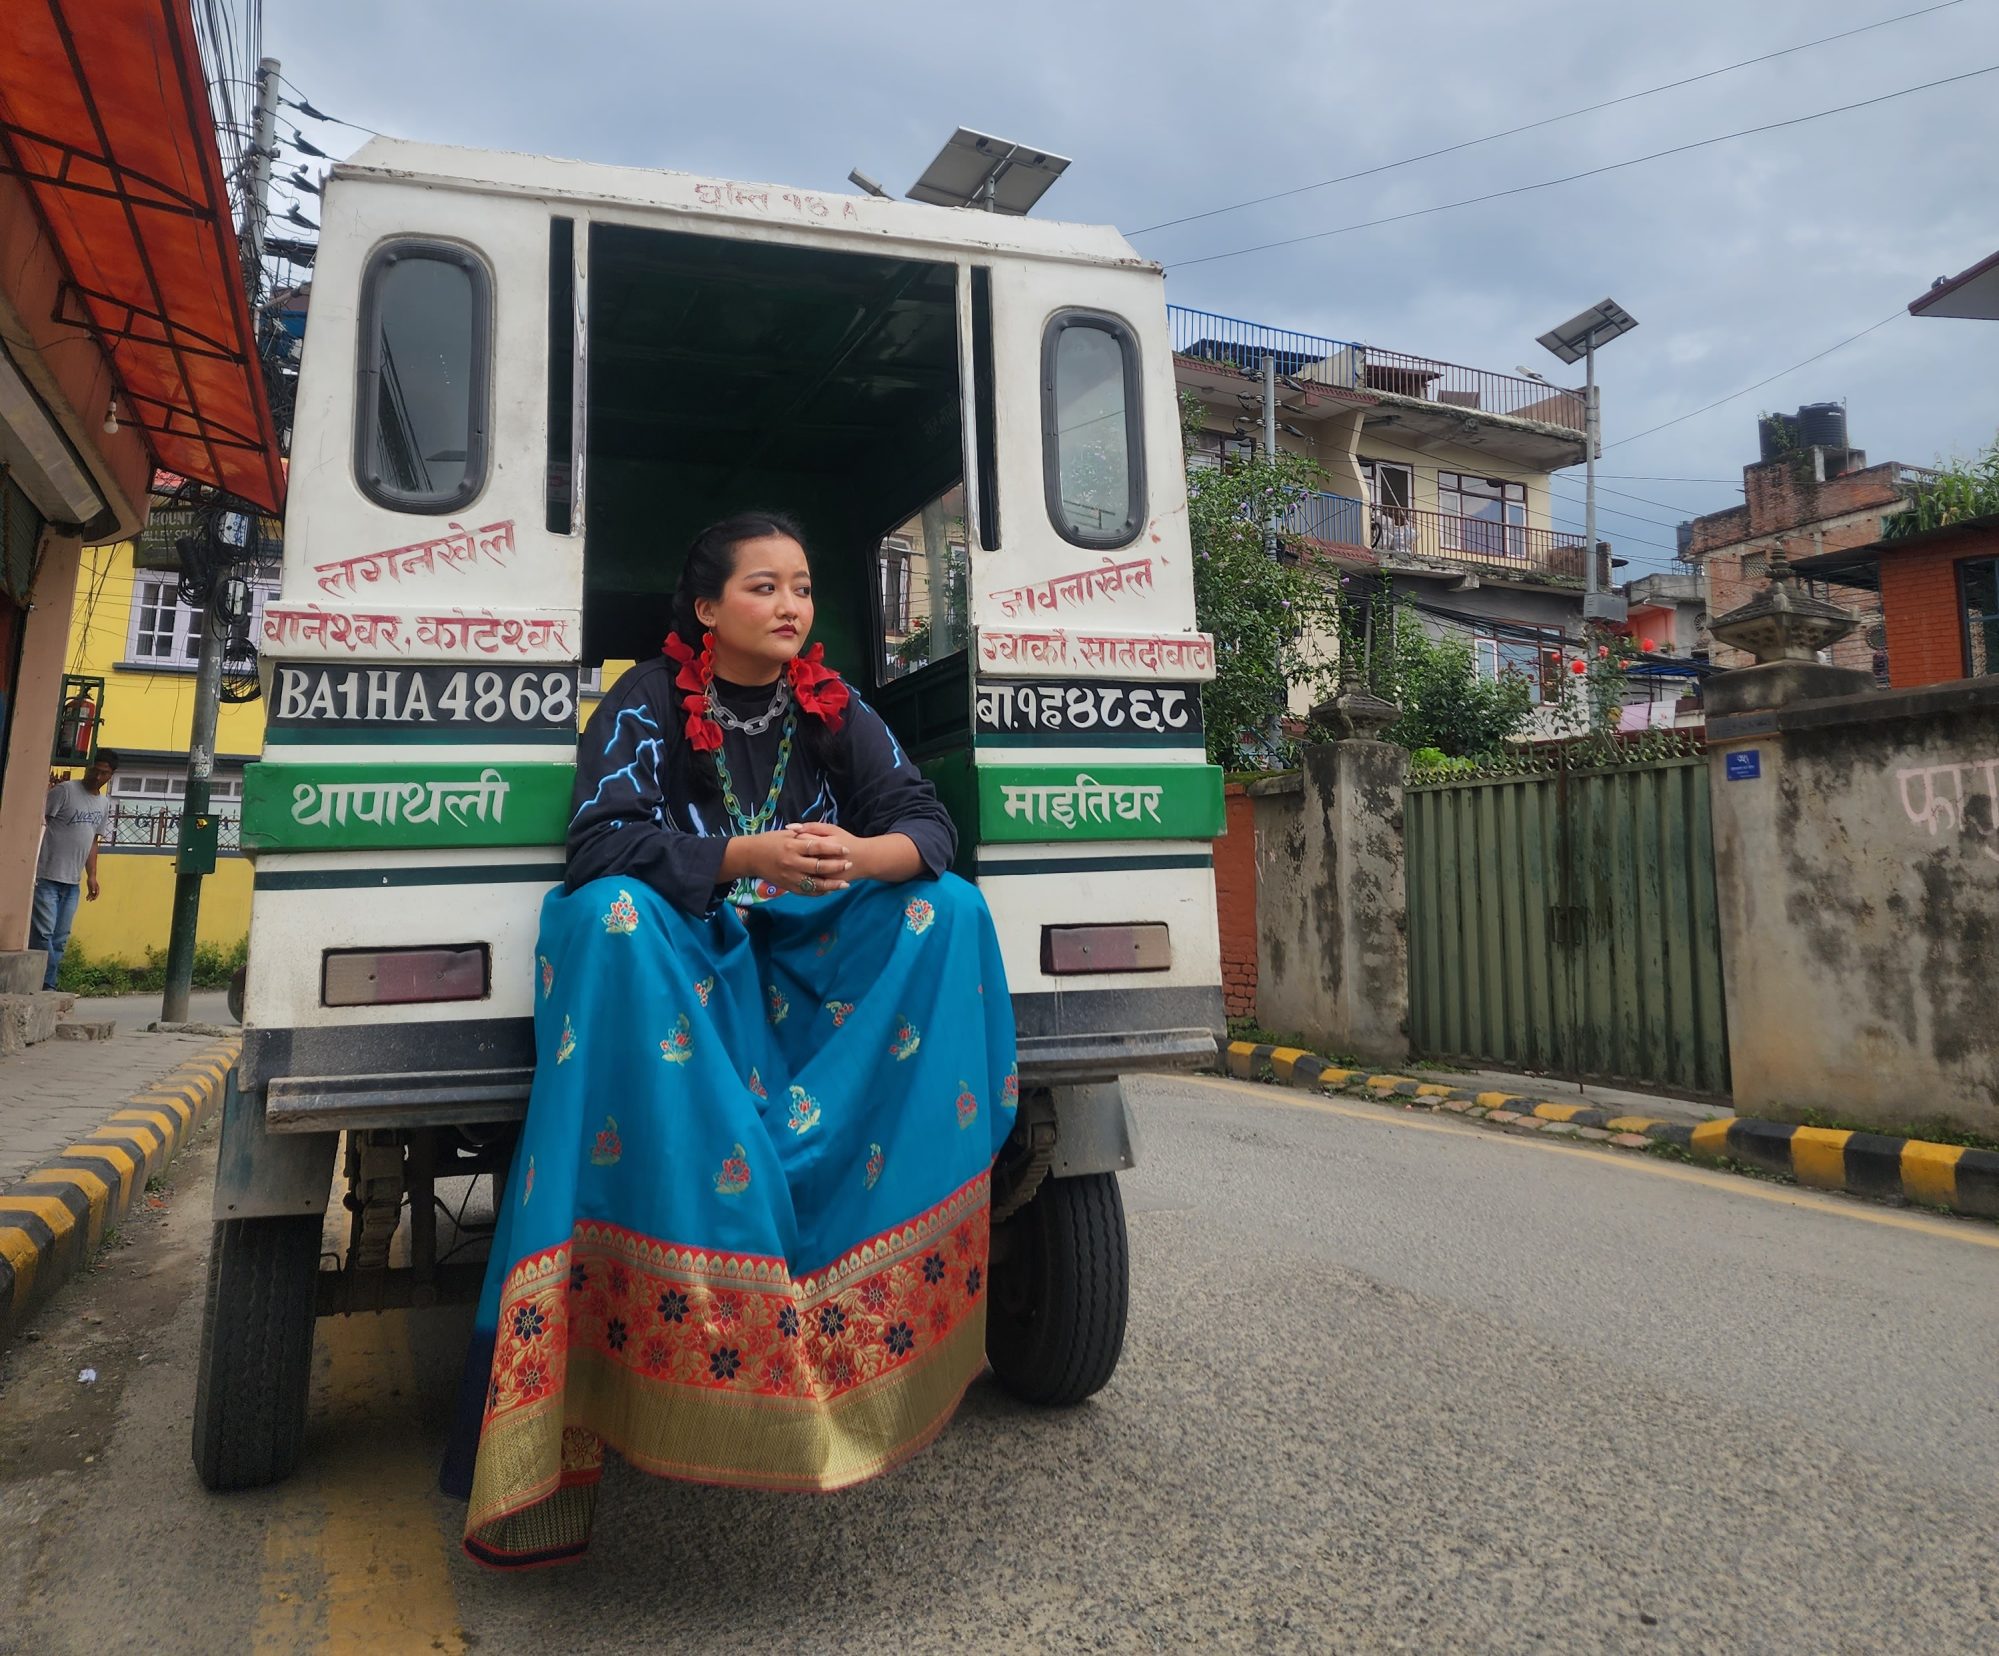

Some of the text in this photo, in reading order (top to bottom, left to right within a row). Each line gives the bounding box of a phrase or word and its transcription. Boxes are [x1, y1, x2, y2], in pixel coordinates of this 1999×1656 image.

[149, 511, 195, 526] MOUNT
[313, 519, 516, 598] लगनखेल
[291, 768, 510, 829] थापाथली
[1000, 773, 1164, 830] माइतिघर
